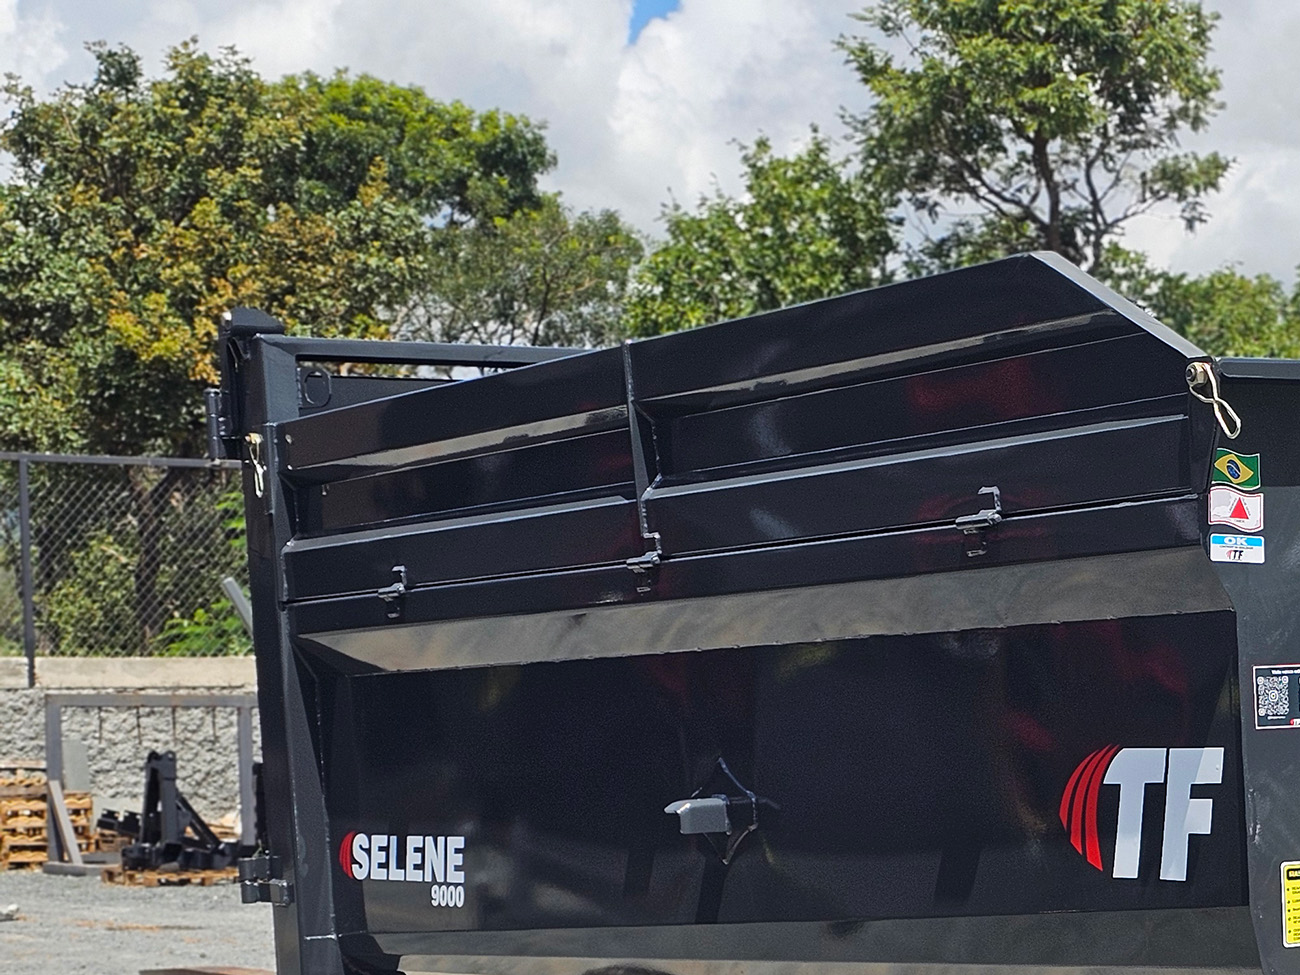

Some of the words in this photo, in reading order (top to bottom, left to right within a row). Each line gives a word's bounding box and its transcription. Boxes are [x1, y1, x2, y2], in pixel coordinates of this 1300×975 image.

[1223, 536, 1248, 546] OK
[1103, 746, 1225, 882] TF
[352, 833, 465, 884] SELENE
[431, 885, 465, 908] 9000
